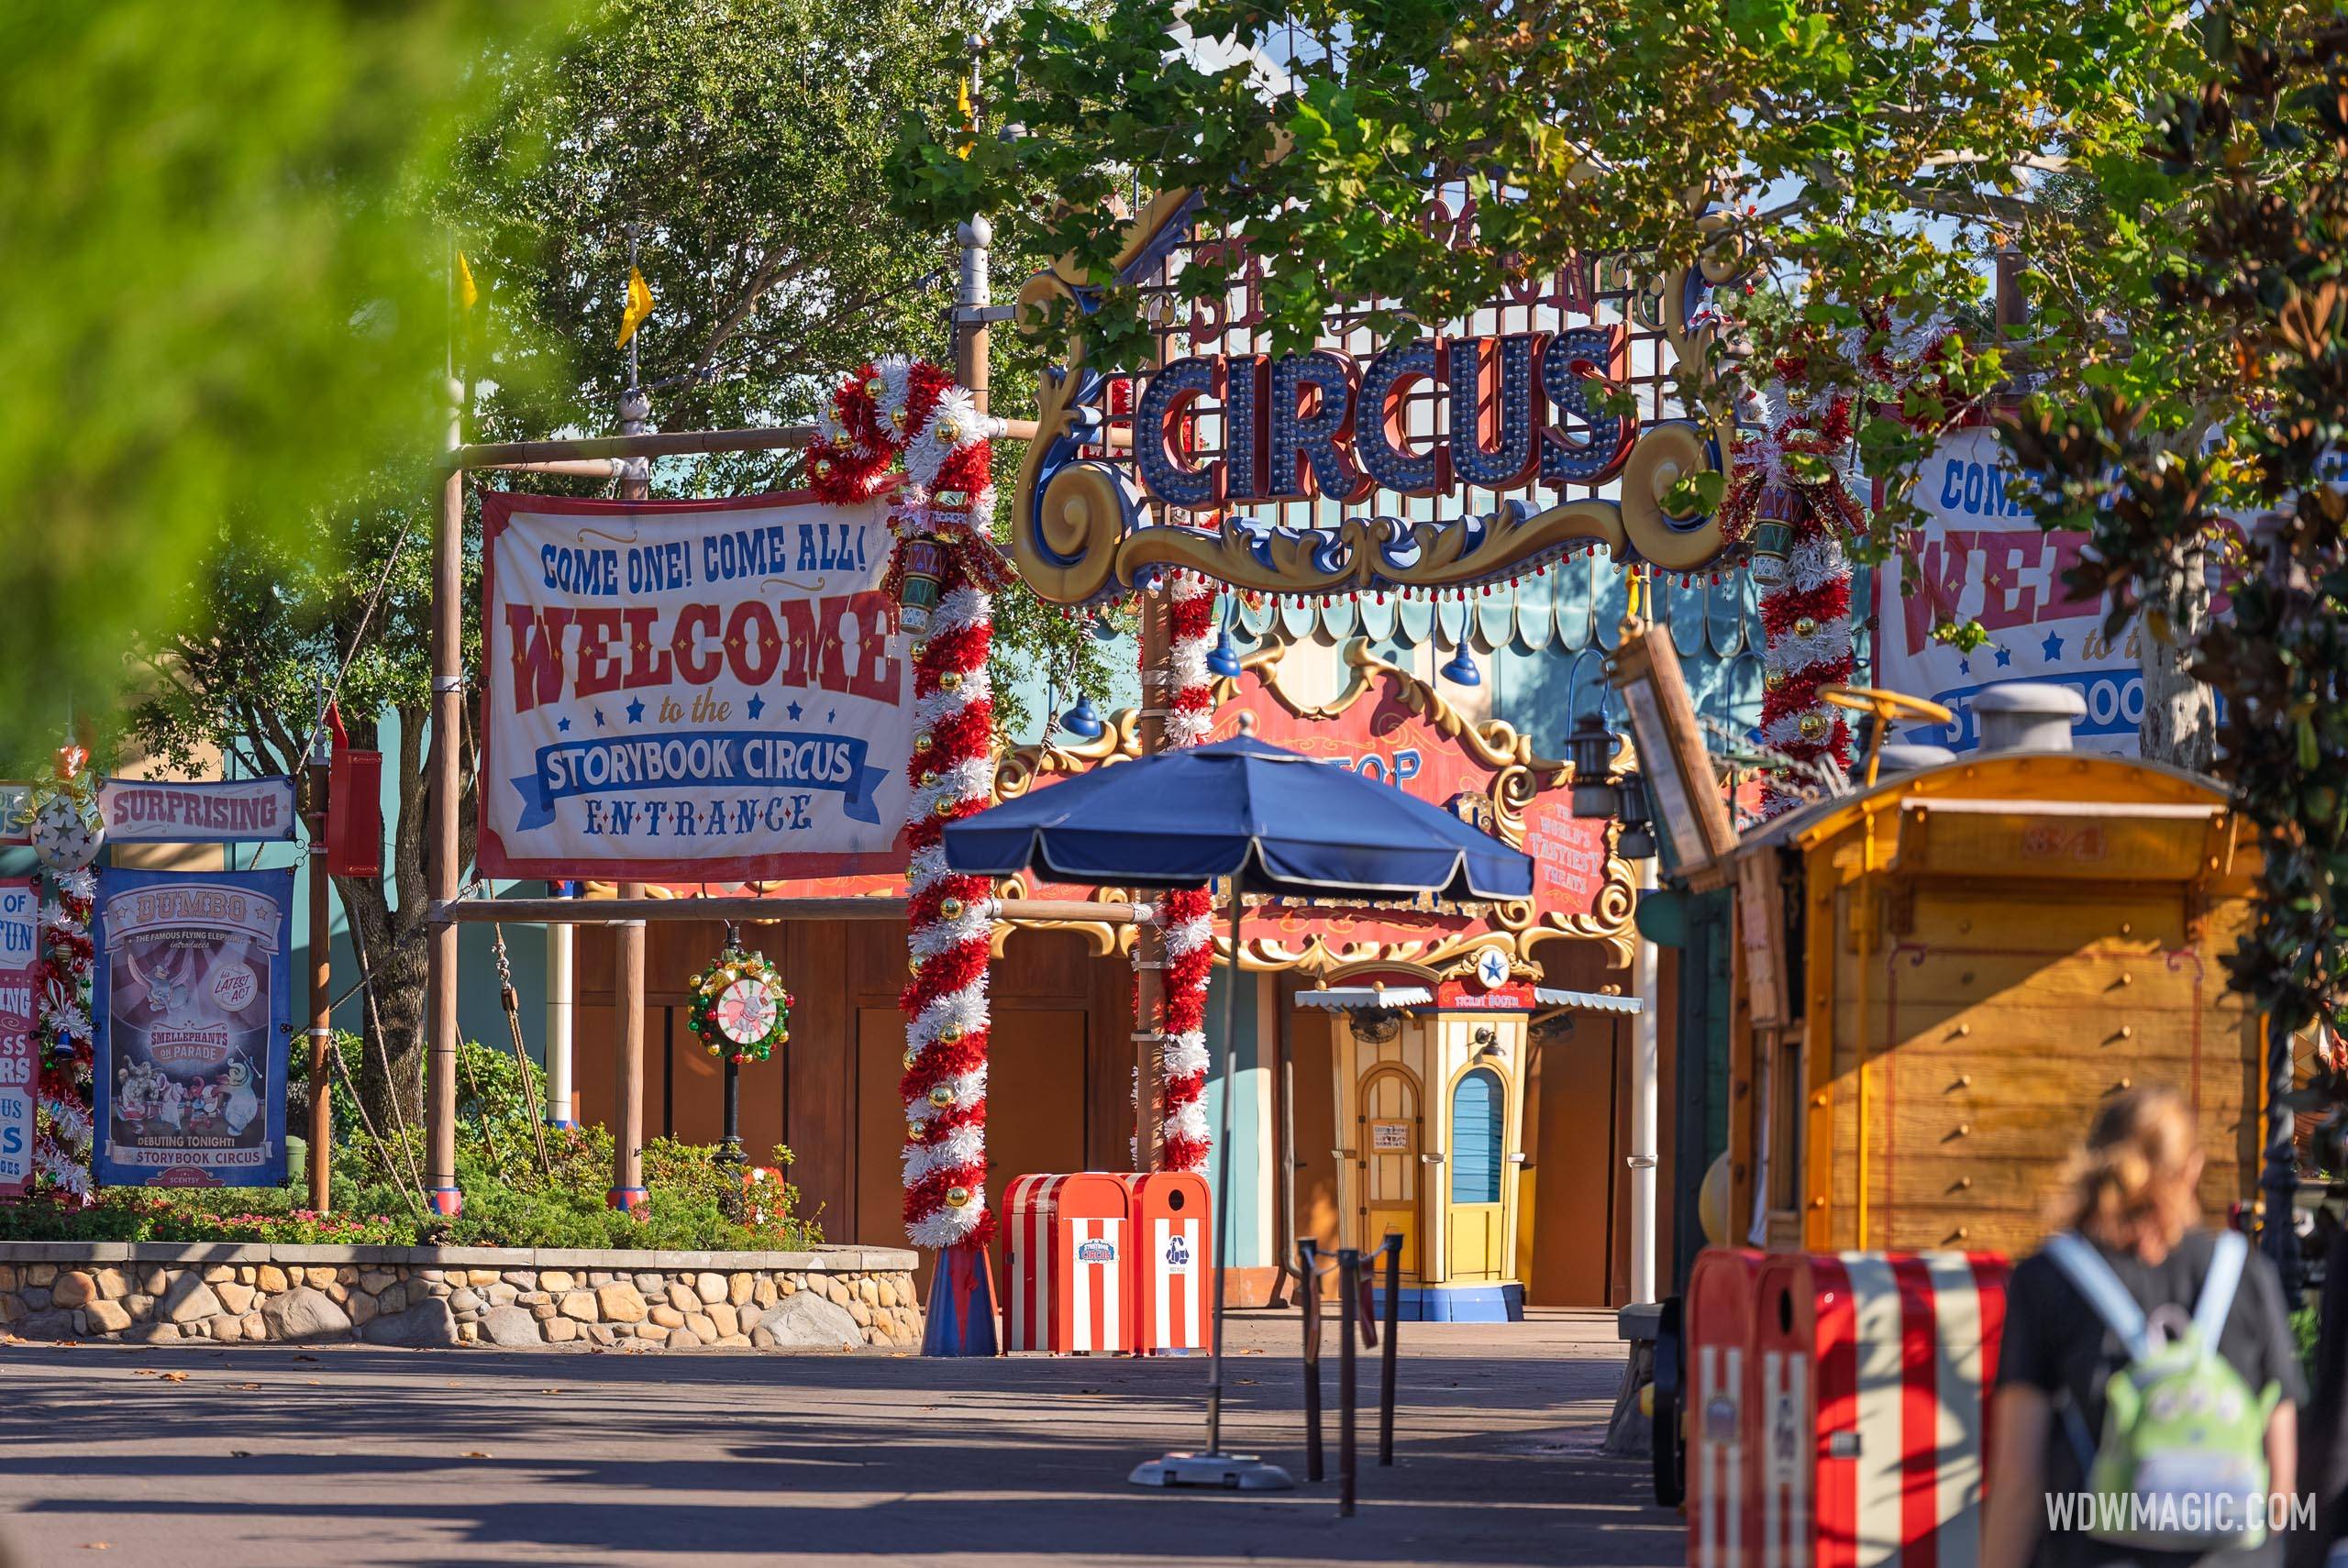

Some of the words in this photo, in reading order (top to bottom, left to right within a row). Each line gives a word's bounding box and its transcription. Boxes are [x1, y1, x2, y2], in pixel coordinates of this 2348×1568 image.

[1135, 321, 1640, 512] CIRCUS
[541, 543, 619, 596] COME
[628, 541, 692, 594] ONE!
[703, 525, 787, 583] COME
[797, 524, 867, 571] ALL!
[505, 591, 902, 714] WELCOME
[659, 694, 685, 724] to
[691, 686, 733, 724] the
[547, 739, 736, 790] STORYBOOK
[742, 738, 853, 783] CIRCUS
[1324, 747, 1423, 792] OP
[113, 790, 277, 831] SURPRISING
[1529, 833, 1601, 878] TASTIEST
[1543, 865, 1587, 895] TREATS
[4, 894, 27, 913] OF
[137, 890, 248, 922] DUMBO
[136, 934, 150, 944] THE
[150, 932, 181, 940] FAMOUS
[183, 931, 206, 940] FLYING
[170, 940, 210, 949] introduces
[215, 974, 251, 994] LATEST
[231, 986, 251, 1002] ACT
[151, 1032, 228, 1046] SMELLEPHANTS
[173, 1046, 217, 1060] PARADE
[138, 1136, 183, 1147] DEBUTING
[187, 1136, 236, 1147] TONIGHT!
[137, 1152, 210, 1165] STORYBOOK
[215, 1152, 260, 1165] CIRCUS
